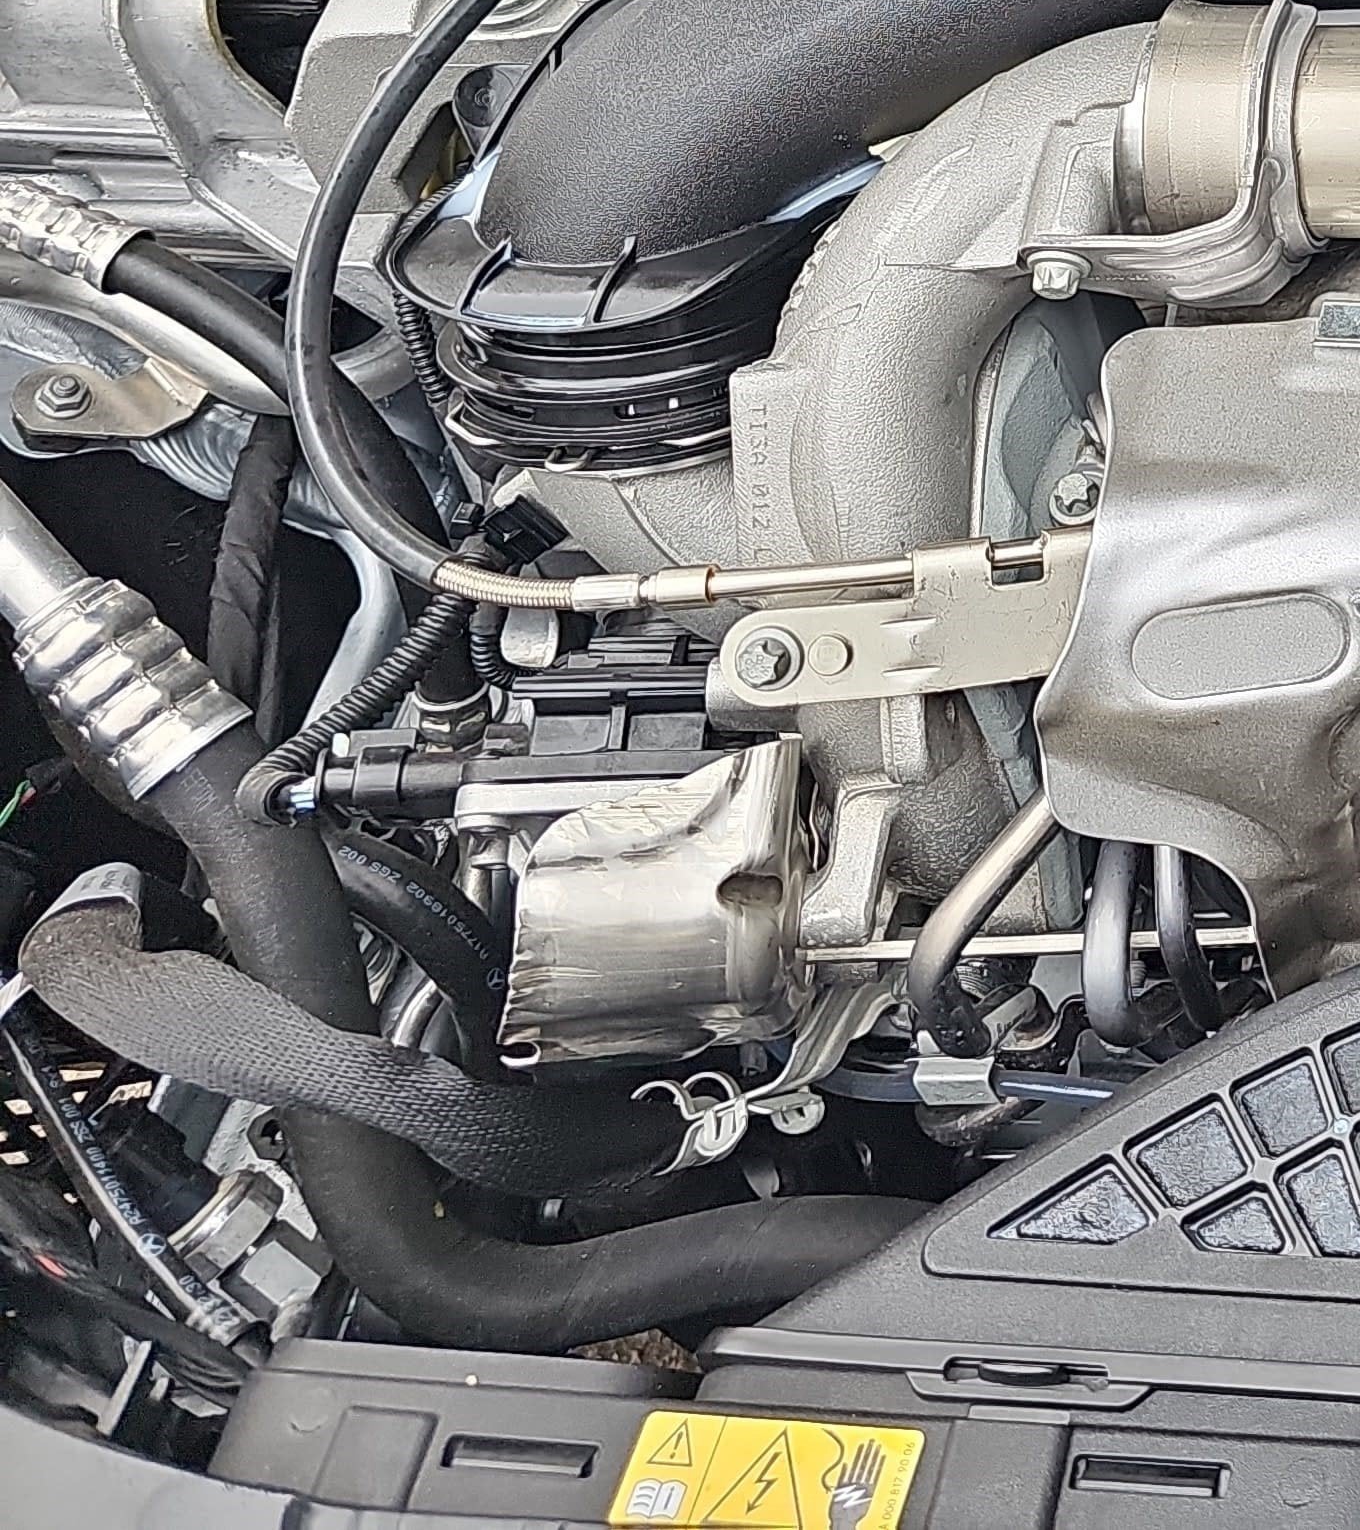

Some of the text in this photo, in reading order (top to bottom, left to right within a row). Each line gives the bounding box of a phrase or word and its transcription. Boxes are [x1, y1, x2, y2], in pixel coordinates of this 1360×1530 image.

[337, 845, 368, 865] 002
[367, 861, 402, 884] ZGS
[58, 1096, 82, 1119] 001
[903, 1440, 916, 1456] 06
[898, 1458, 910, 1473] 90
[882, 1498, 897, 1521] 000
